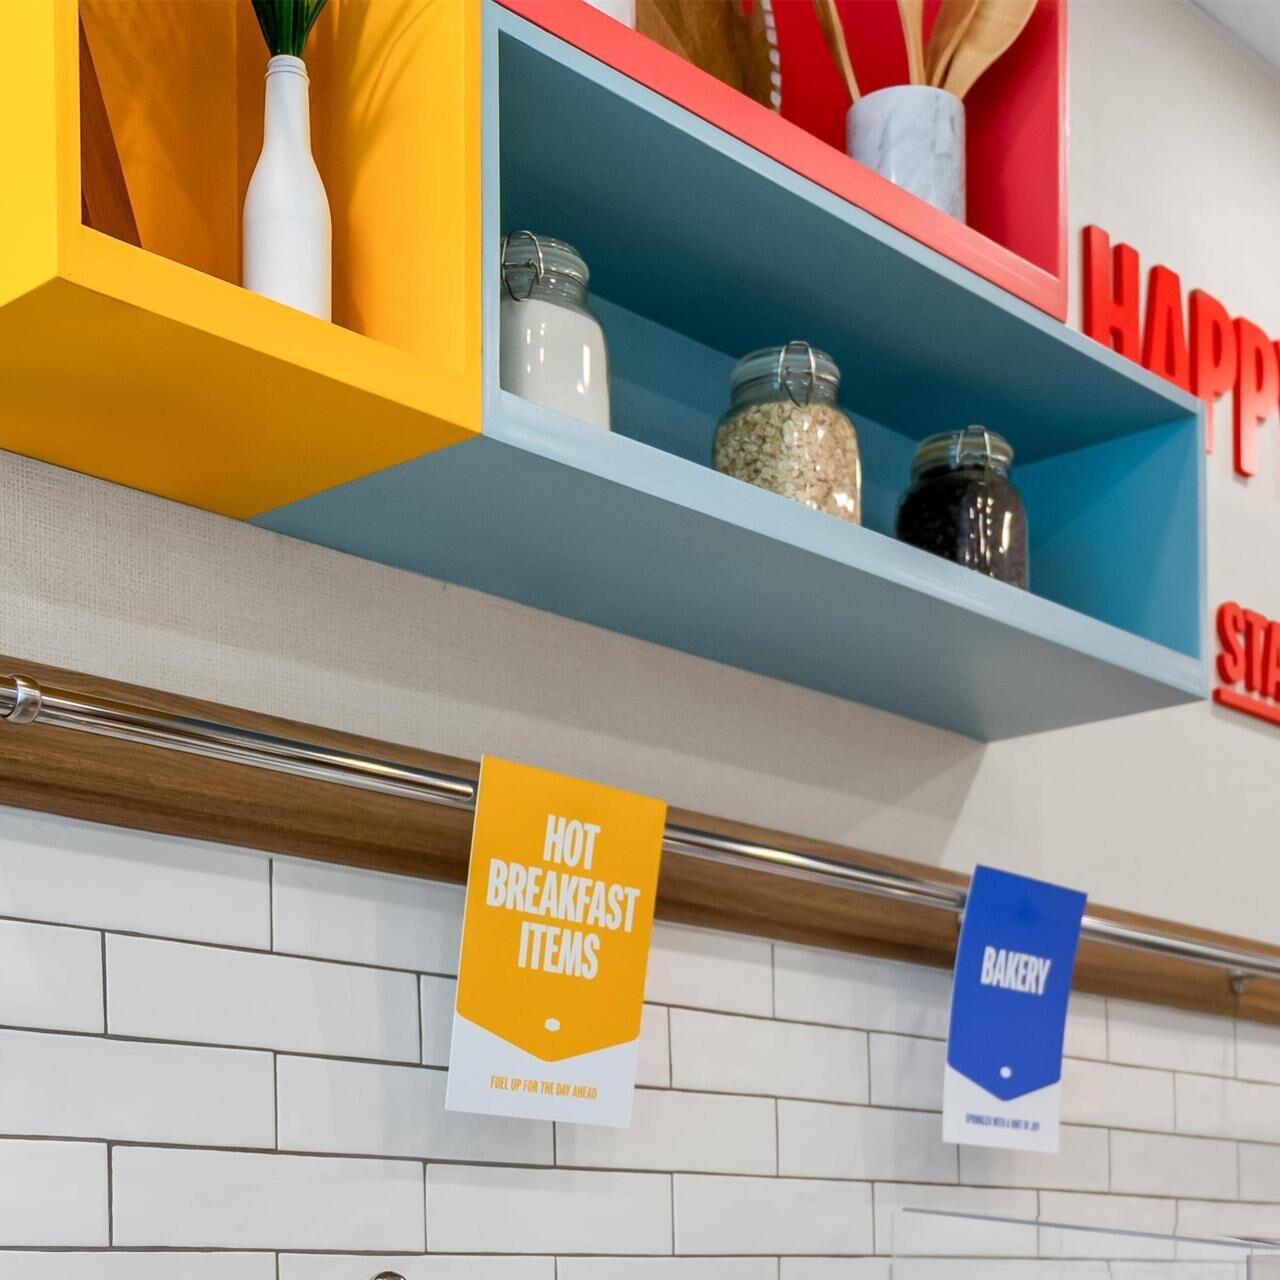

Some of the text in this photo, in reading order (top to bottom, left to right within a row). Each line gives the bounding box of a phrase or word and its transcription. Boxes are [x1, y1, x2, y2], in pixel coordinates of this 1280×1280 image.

[542, 814, 601, 870] HOT
[486, 858, 640, 932] BREAKFAST
[517, 921, 601, 980] ITEMS
[980, 946, 1052, 995] BAKERY
[490, 1075, 598, 1100] FUEL UP FOR THE DAY AHEAD
